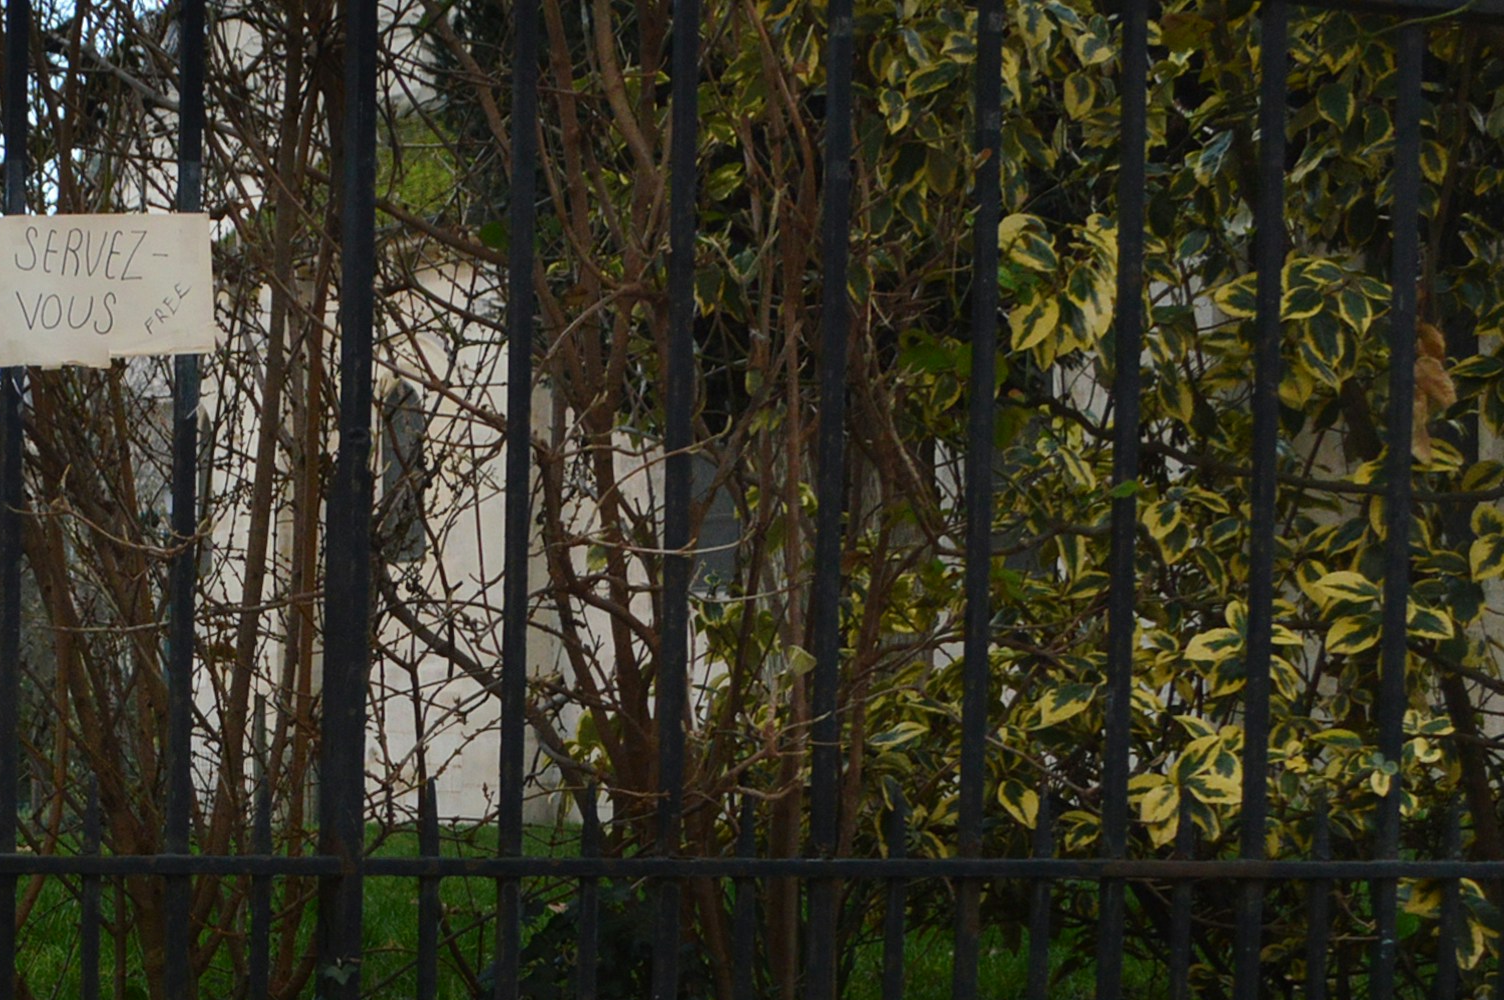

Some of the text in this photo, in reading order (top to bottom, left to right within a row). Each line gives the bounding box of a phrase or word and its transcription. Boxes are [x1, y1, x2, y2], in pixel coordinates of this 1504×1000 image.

[15, 226, 168, 281] SERVEZ-
[16, 291, 116, 335] VOUS
[144, 282, 192, 335] FREE
